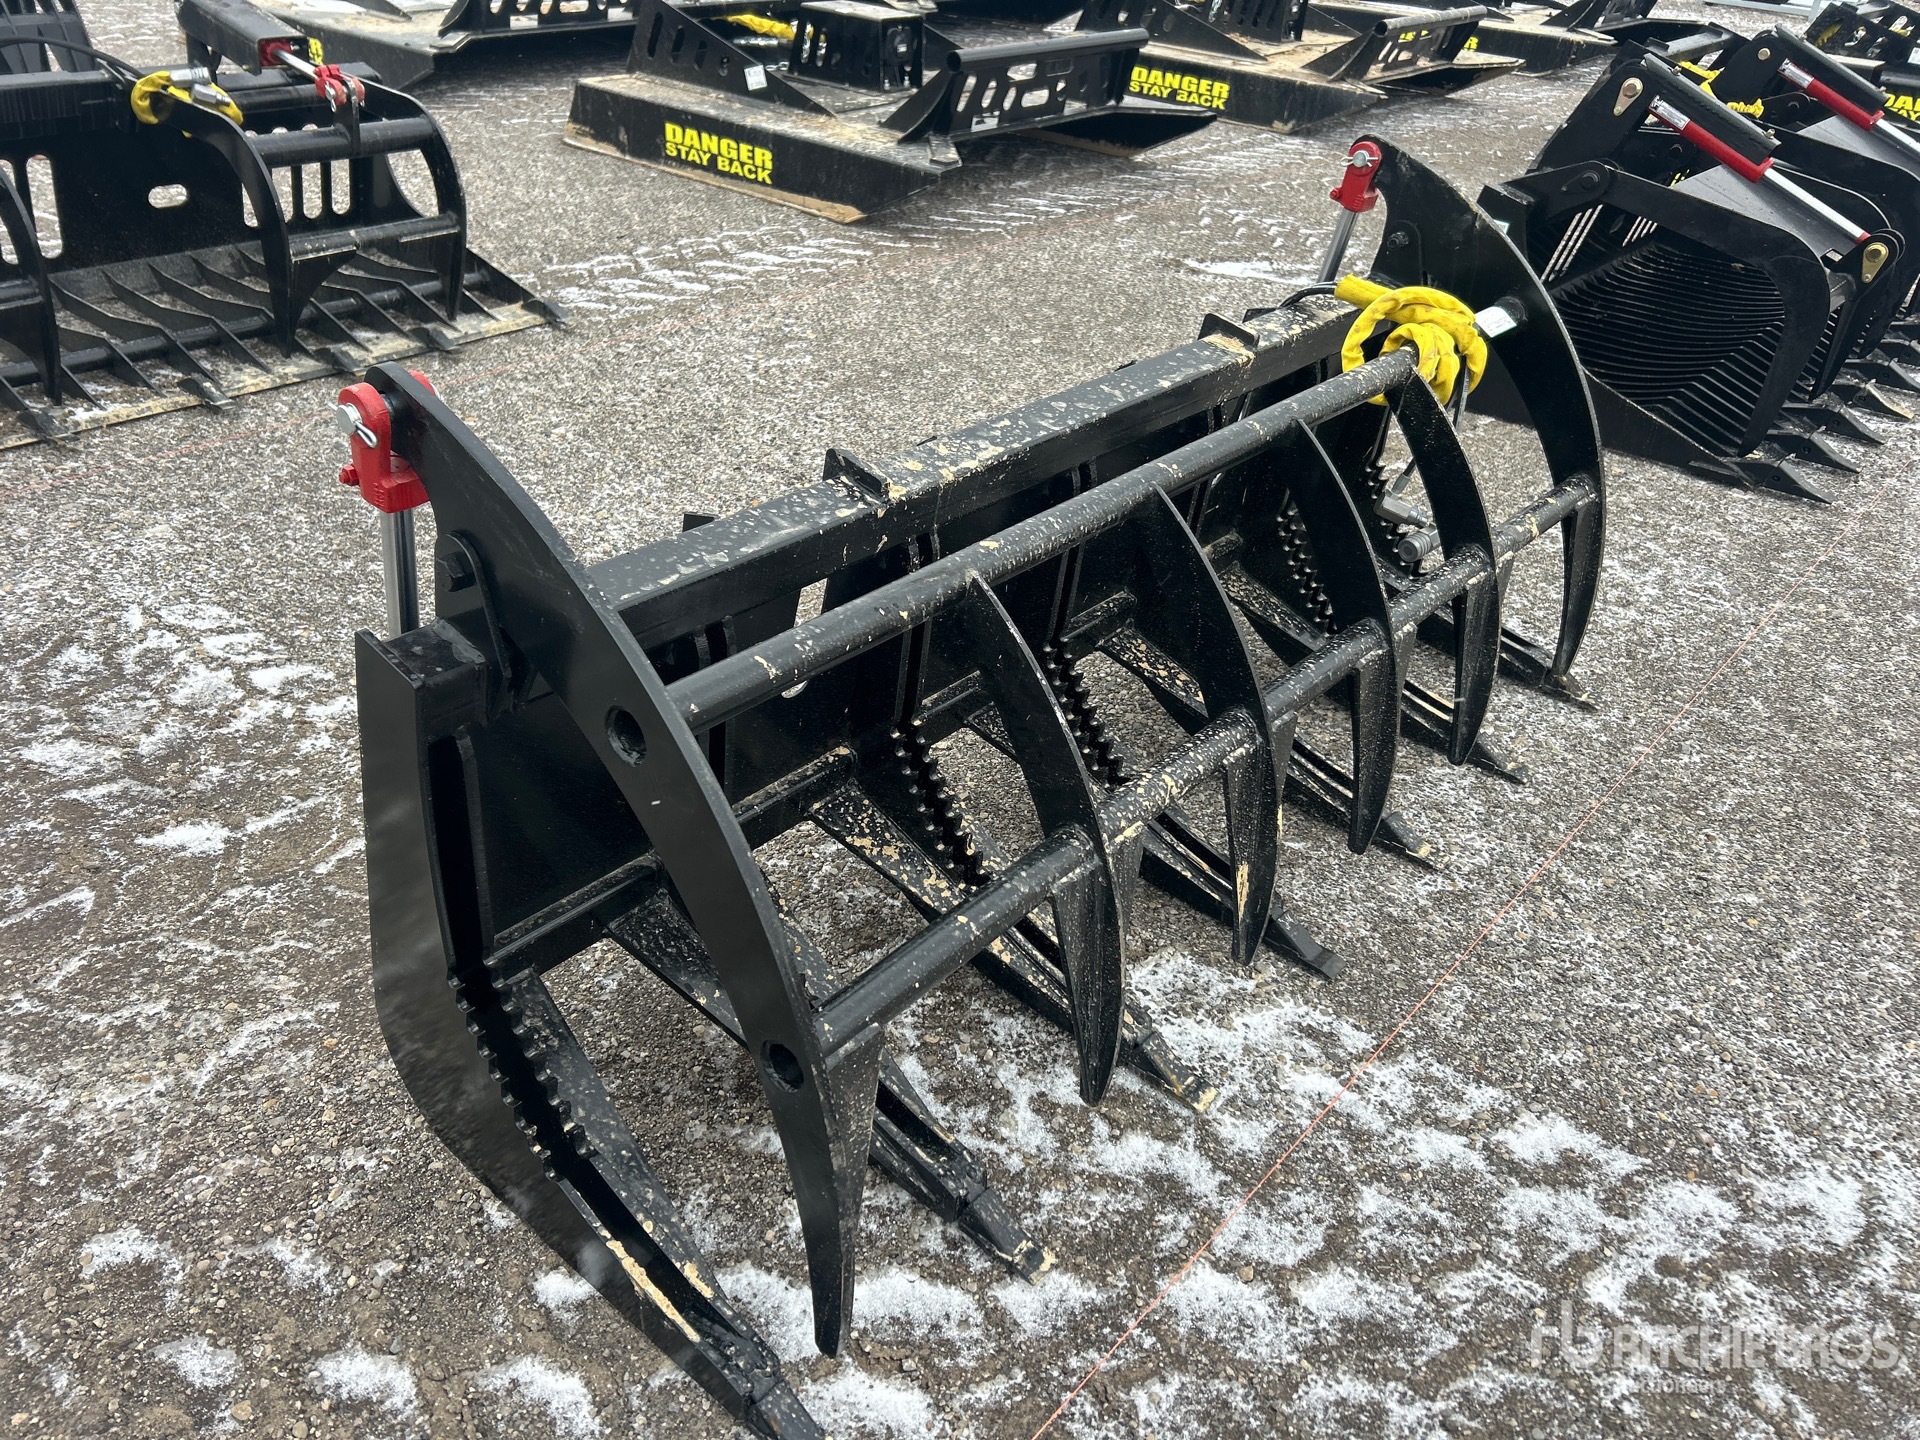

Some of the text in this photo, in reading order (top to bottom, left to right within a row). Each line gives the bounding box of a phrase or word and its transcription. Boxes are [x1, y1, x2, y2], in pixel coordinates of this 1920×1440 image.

[1129, 81, 1227, 110] STAY BACK
[1131, 66, 1230, 98] DANGER
[665, 122, 772, 169] DANGER
[665, 142, 772, 184] STAY BACK
